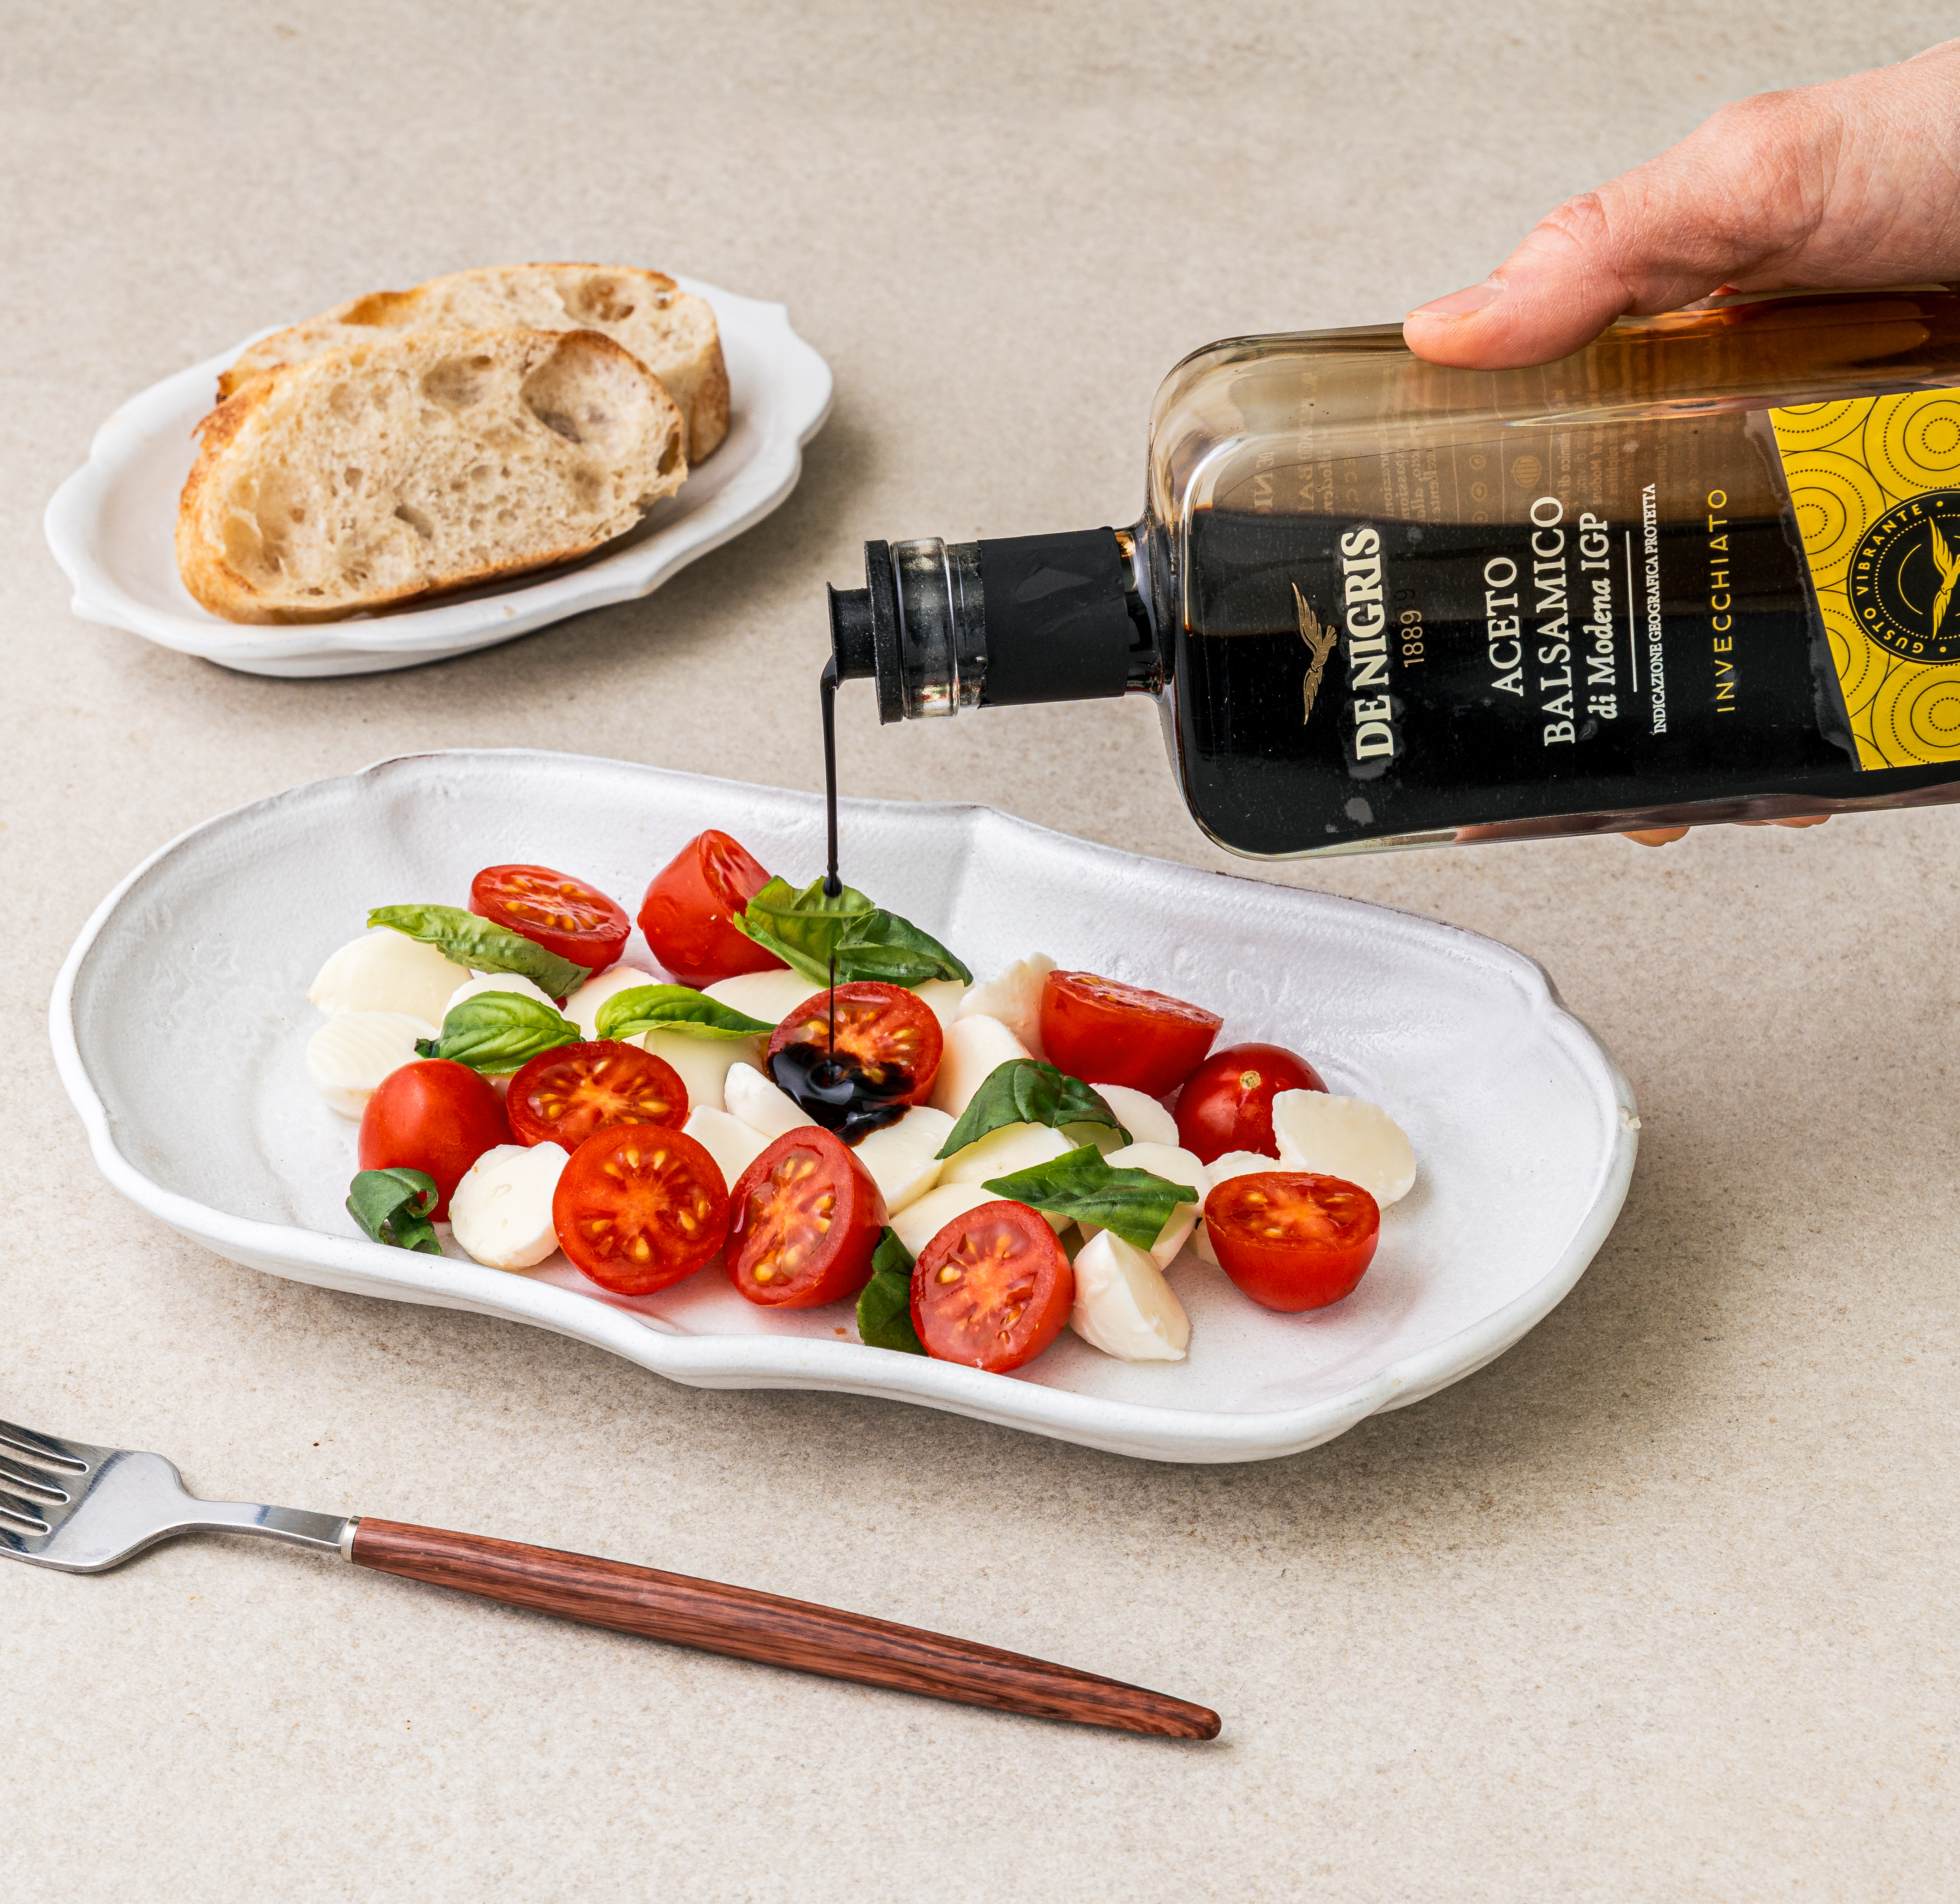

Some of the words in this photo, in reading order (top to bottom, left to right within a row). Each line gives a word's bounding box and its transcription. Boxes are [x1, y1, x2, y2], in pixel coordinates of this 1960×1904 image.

[1579, 512, 1610, 572] IGP
[1642, 483, 1658, 554] PROTETTA
[1856, 503, 1923, 596] VIBRANTE
[1341, 528, 1390, 691] NIGRIS
[1401, 610, 1424, 668] 1889
[1484, 557, 1524, 697] ACETO
[1530, 496, 1575, 747] BALSAMICO
[1583, 577, 1616, 686] Modena
[1645, 555, 1662, 642] GEOGRAFICA
[1707, 489, 1736, 713] INVECCHIATO
[1864, 607, 1924, 654] GUSTO
[1354, 695, 1394, 760] DE
[1587, 694, 1618, 719] di
[1649, 643, 1666, 734] INDICAZIONE
